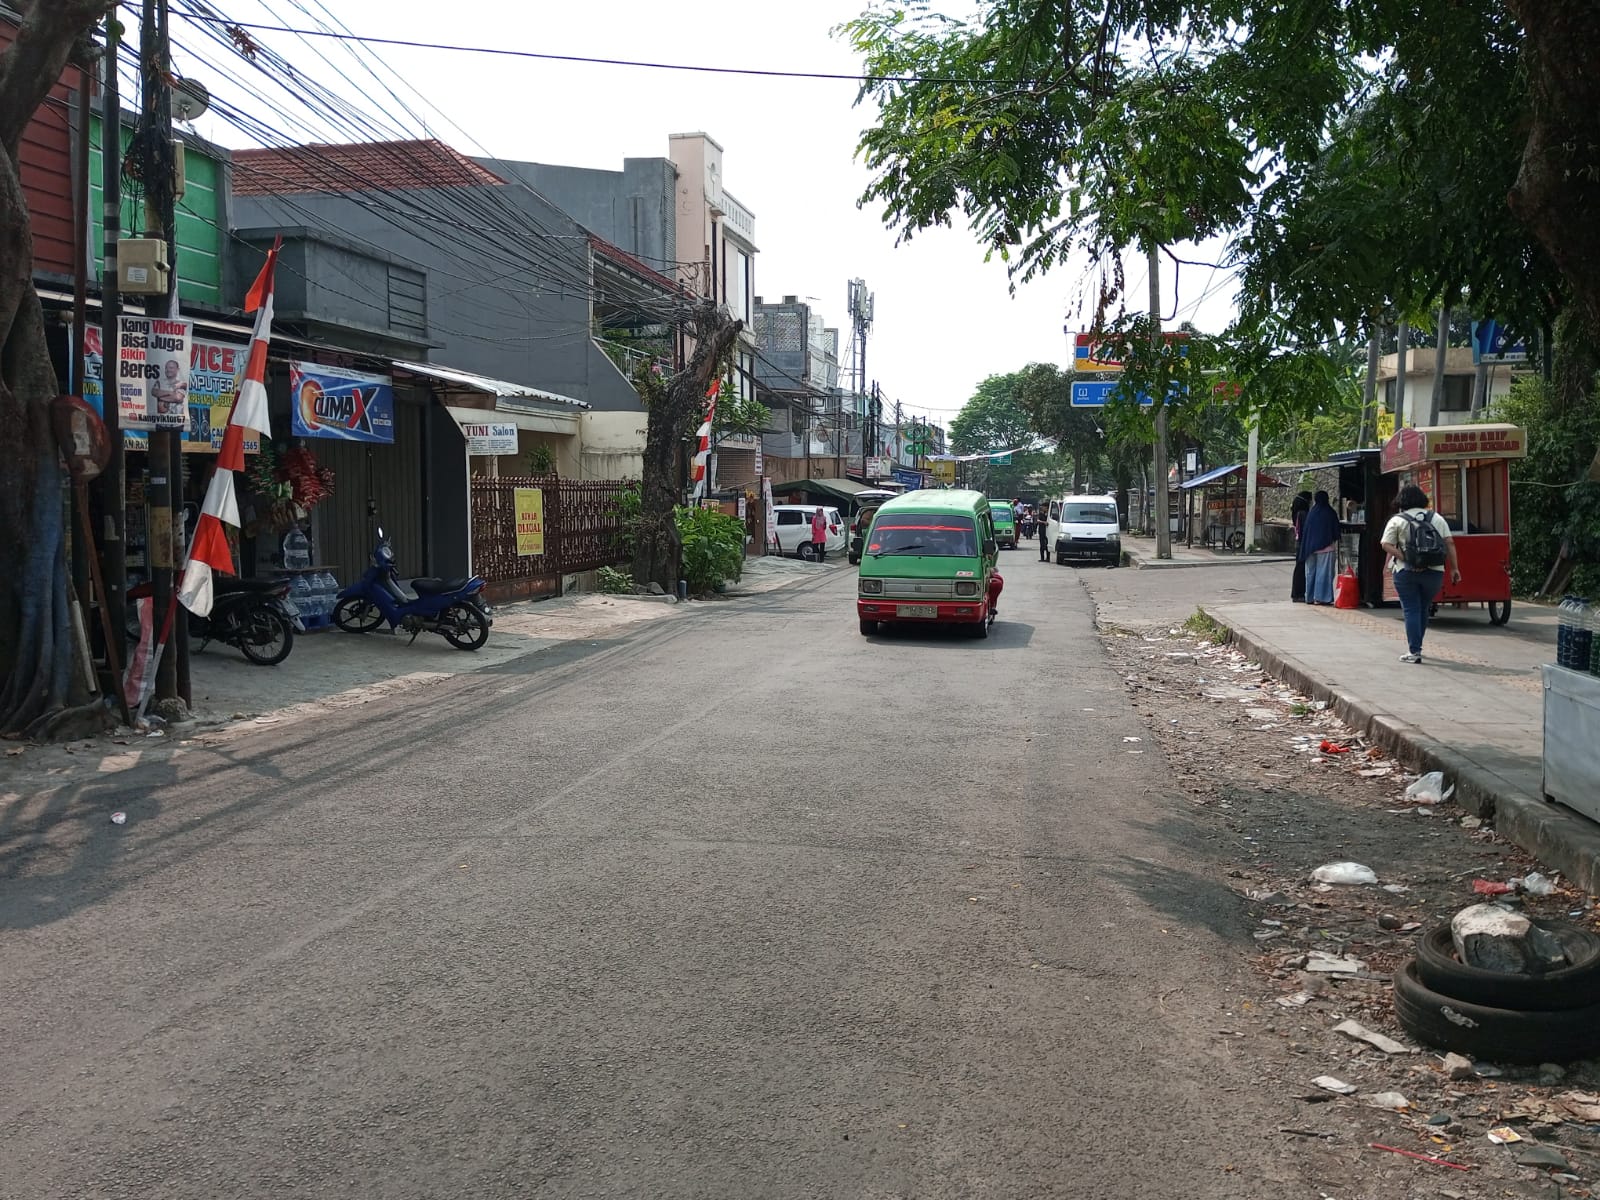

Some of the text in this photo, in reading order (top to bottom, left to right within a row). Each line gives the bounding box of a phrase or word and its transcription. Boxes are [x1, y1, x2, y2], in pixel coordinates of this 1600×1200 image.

[121, 318, 187, 336] Kang Viktor
[121, 333, 148, 349] Bisa
[150, 335, 183, 352] Juga
[120, 348, 145, 361] Bikin
[120, 360, 160, 380] Beres
[465, 424, 515, 437] YUNI Salon
